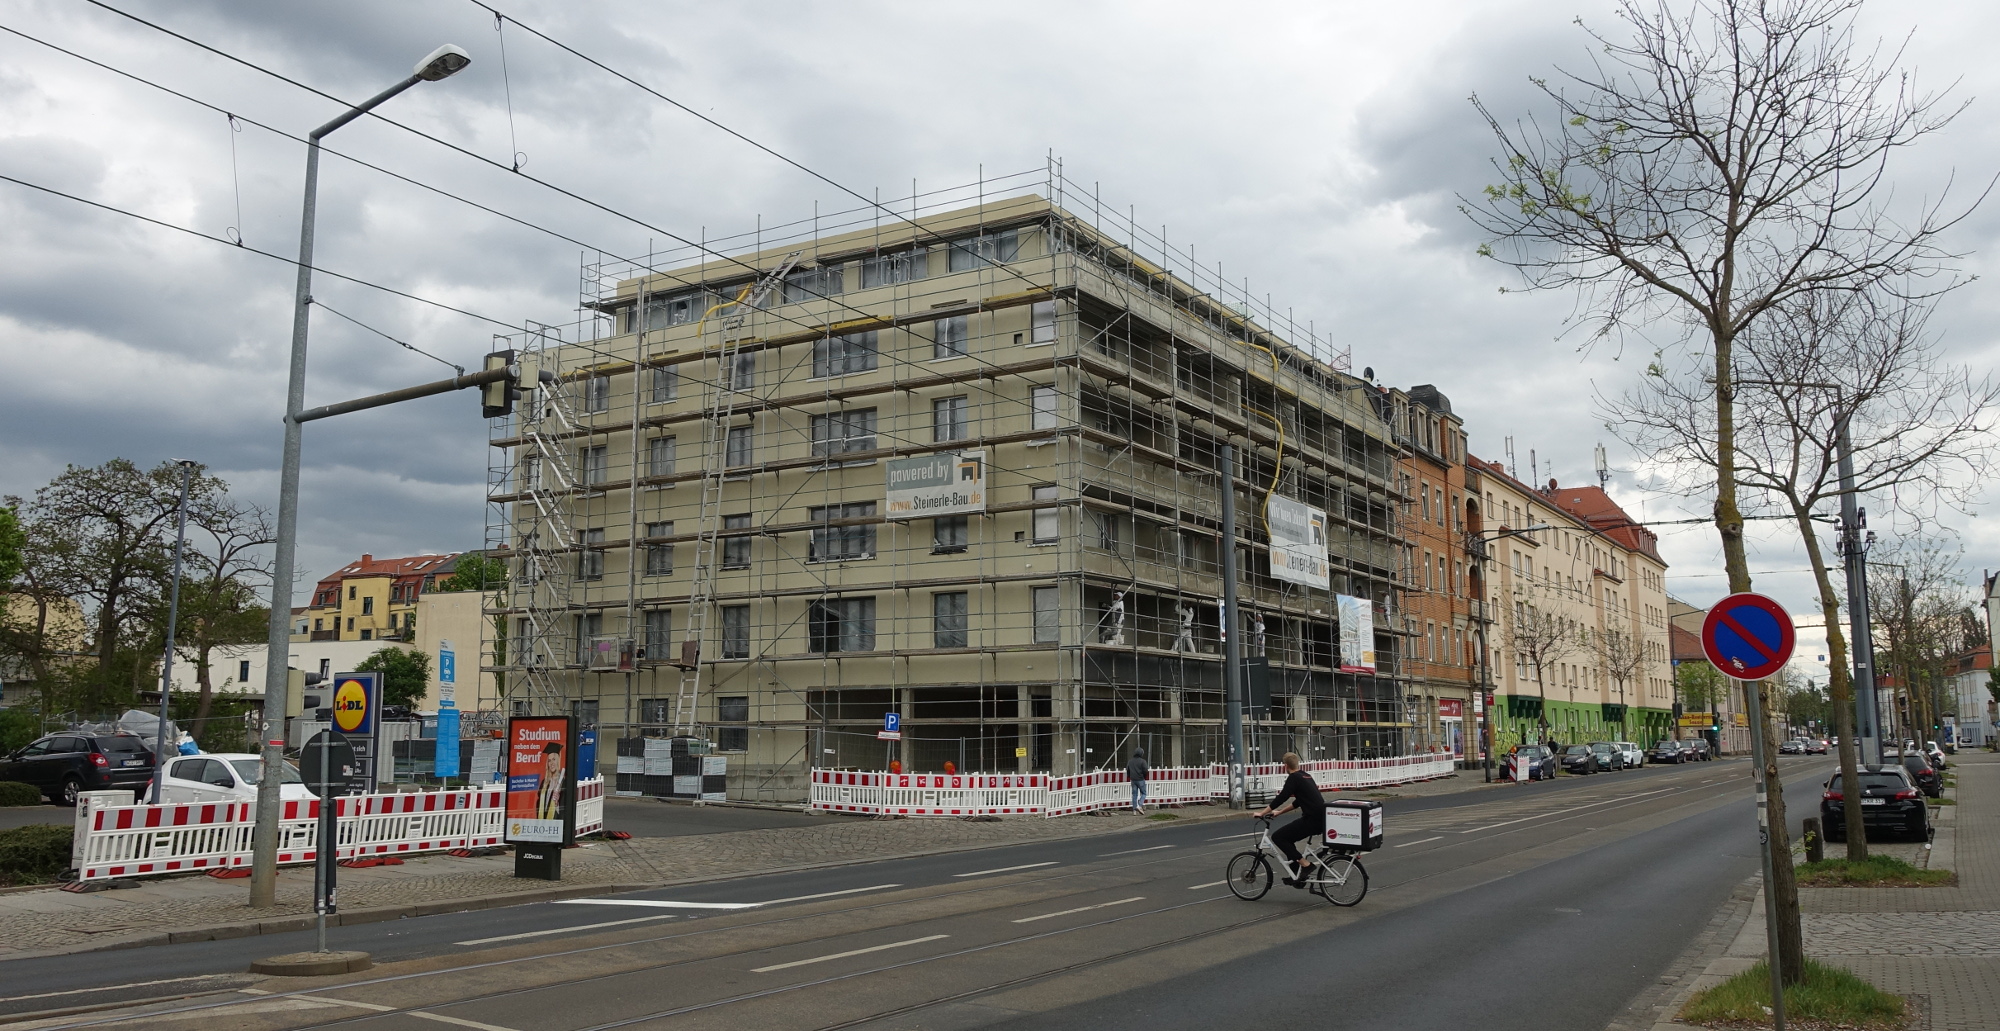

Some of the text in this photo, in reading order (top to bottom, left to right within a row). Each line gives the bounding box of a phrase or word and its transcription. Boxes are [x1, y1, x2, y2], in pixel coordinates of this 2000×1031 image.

[890, 461, 949, 487] powered by
[890, 490, 981, 512] www.Steinerle-Bau.de
[888, 715, 897, 729] P
[519, 727, 560, 741] Studium
[516, 751, 542, 763] Beruf
[521, 825, 559, 835] EURO-FH
